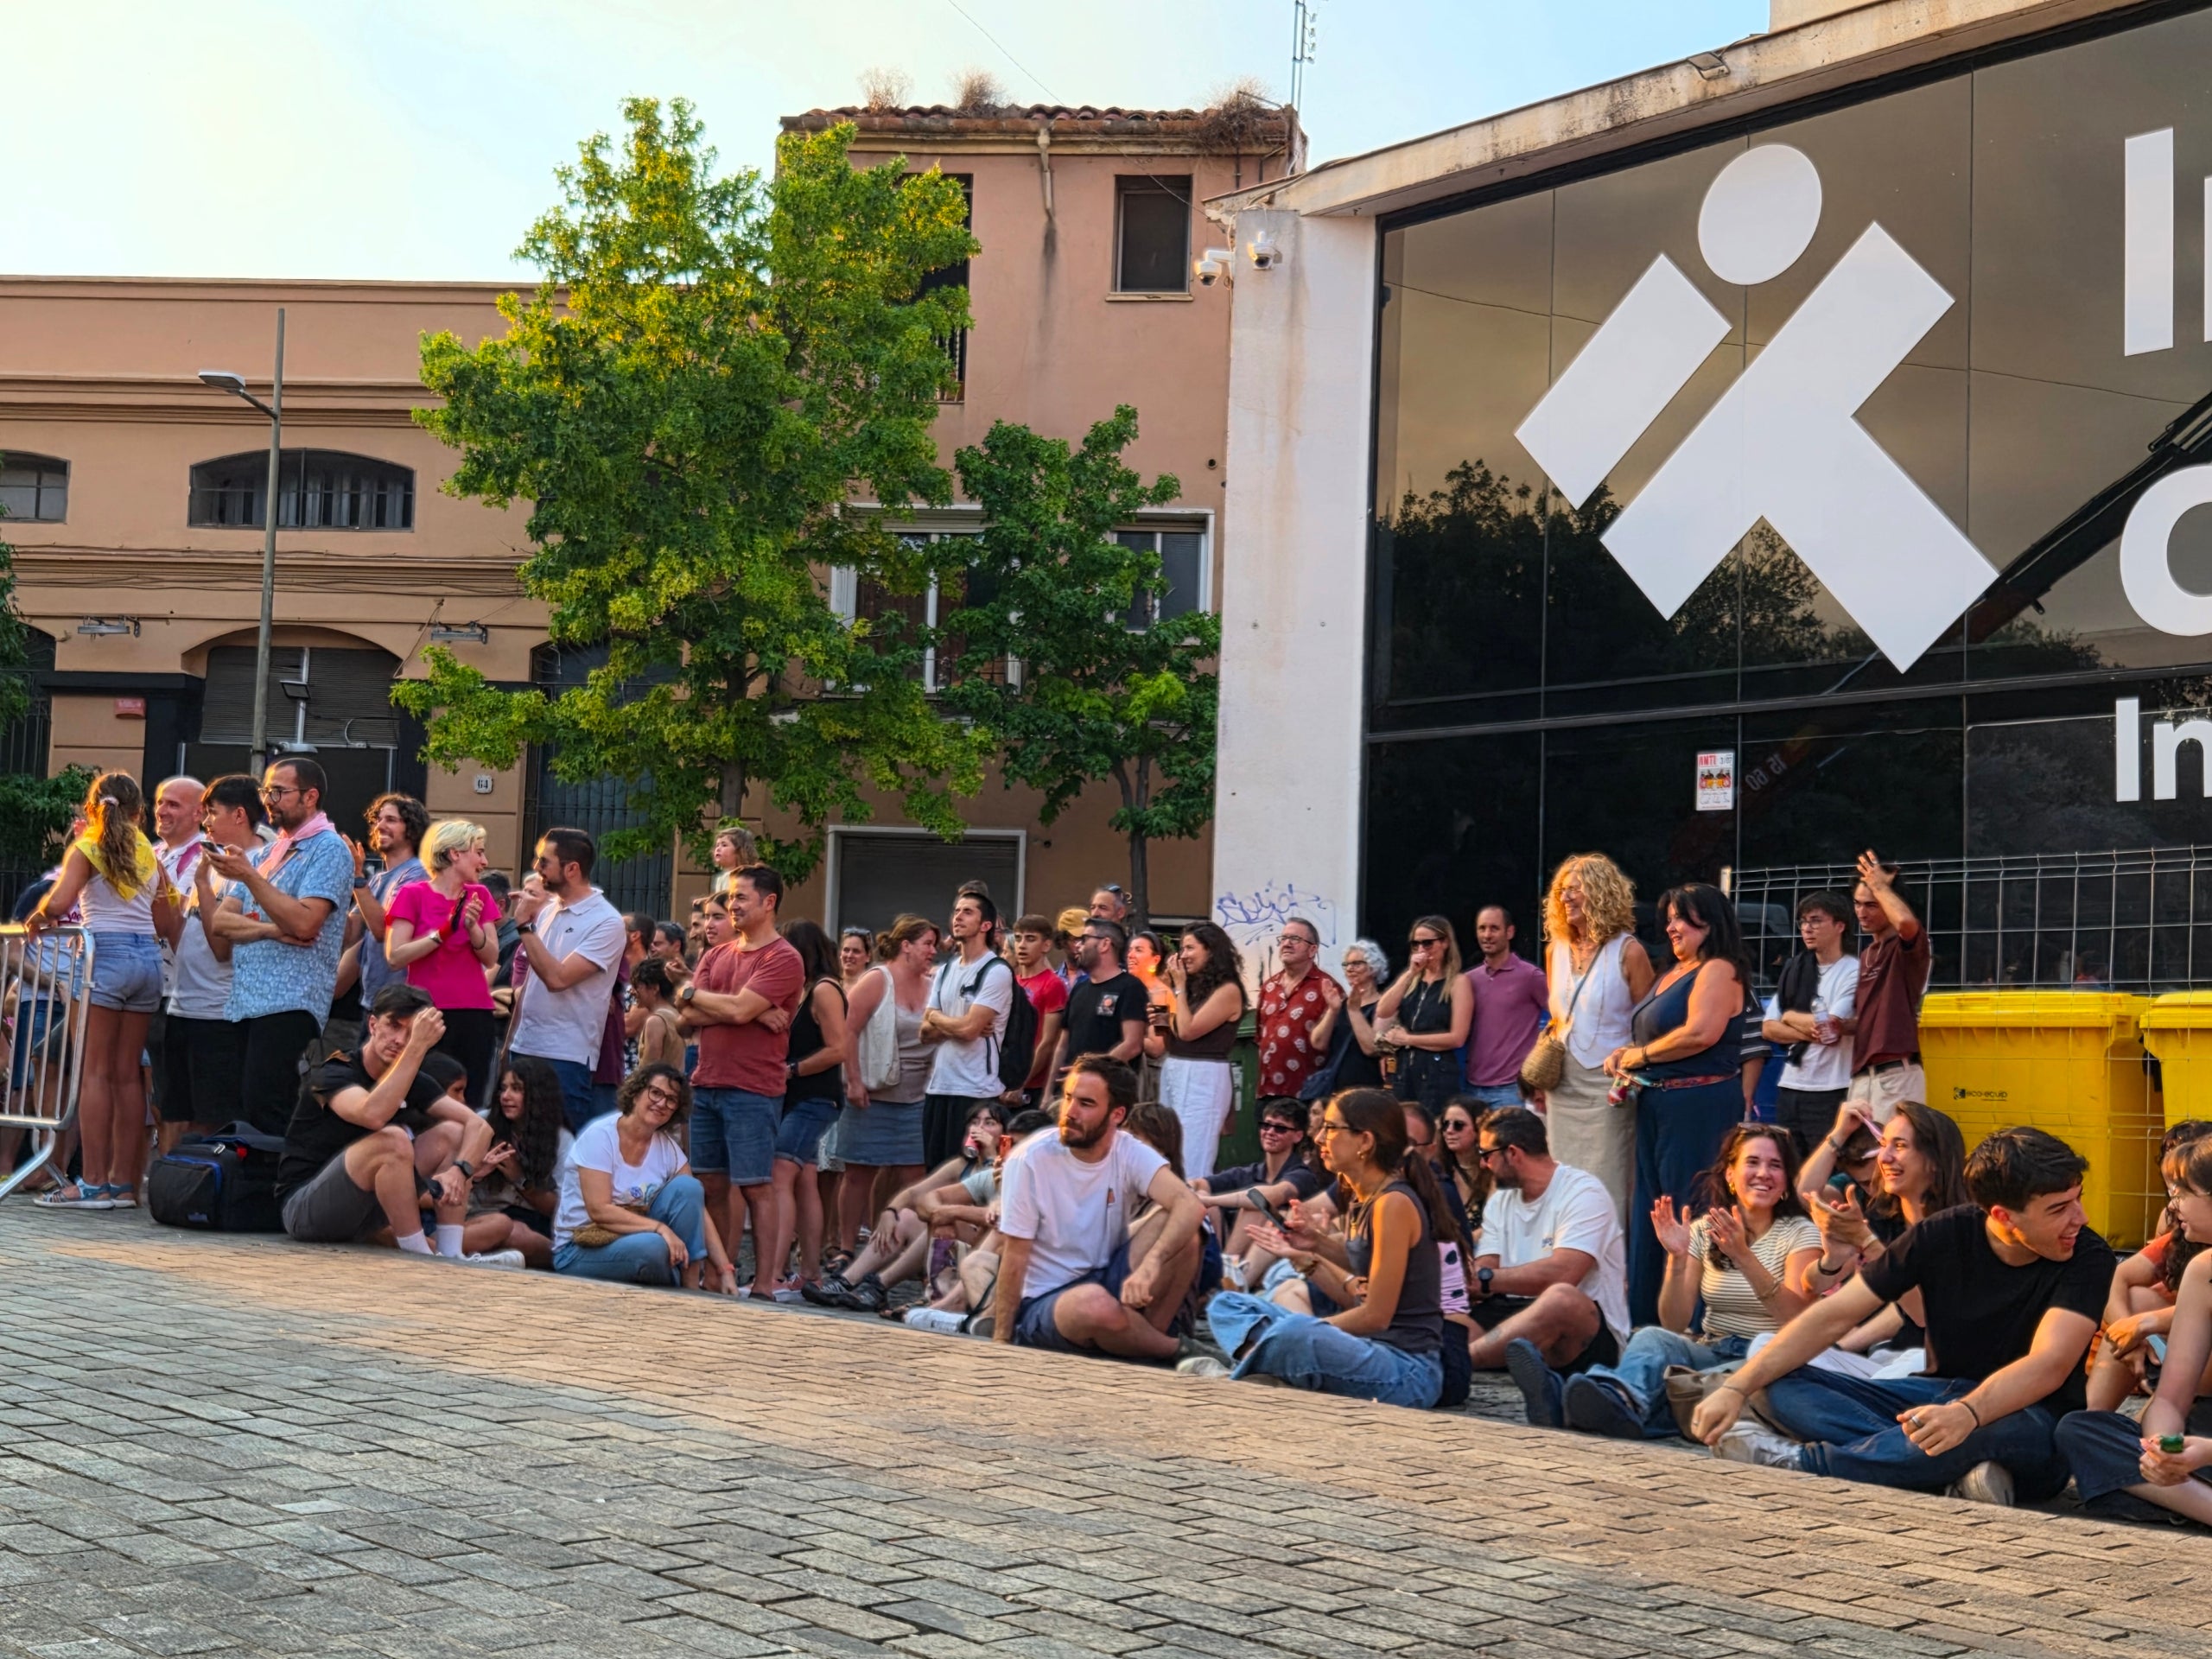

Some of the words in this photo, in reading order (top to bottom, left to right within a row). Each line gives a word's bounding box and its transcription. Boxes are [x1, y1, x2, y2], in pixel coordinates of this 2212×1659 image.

[2124, 126, 2212, 356] I
[477, 779, 489, 790] 64
[2115, 697, 2212, 802] In
